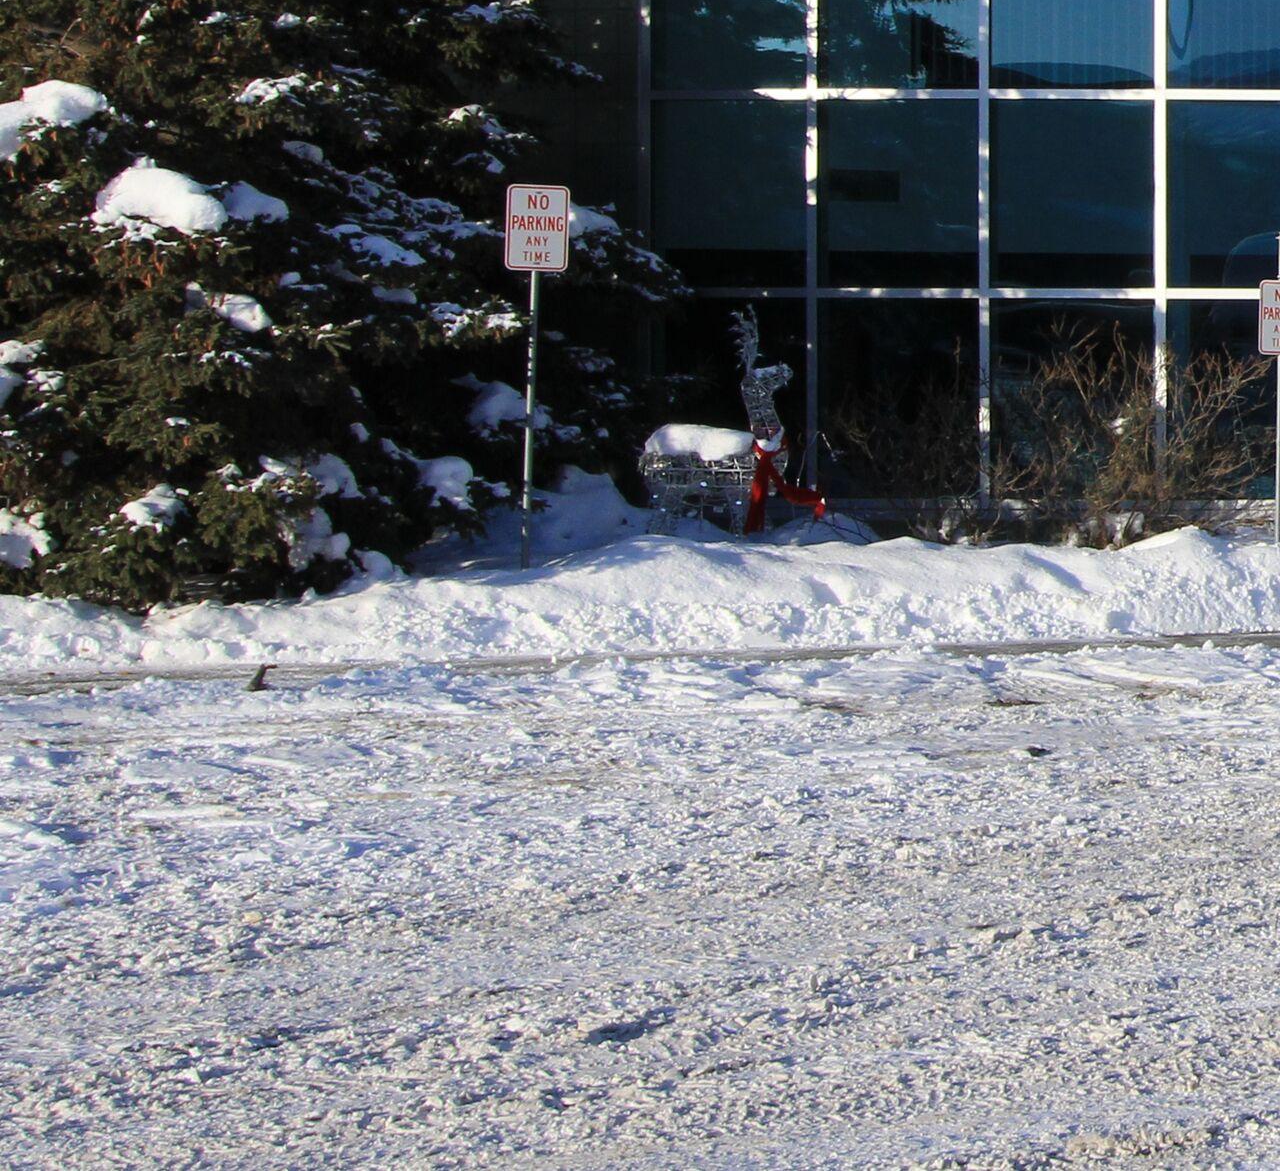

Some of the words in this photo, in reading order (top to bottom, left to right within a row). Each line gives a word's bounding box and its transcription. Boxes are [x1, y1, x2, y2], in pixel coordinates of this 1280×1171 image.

[527, 194, 550, 210] NO
[511, 215, 564, 232] PARKING
[525, 236, 549, 247] ANY
[522, 250, 551, 263] TIME
